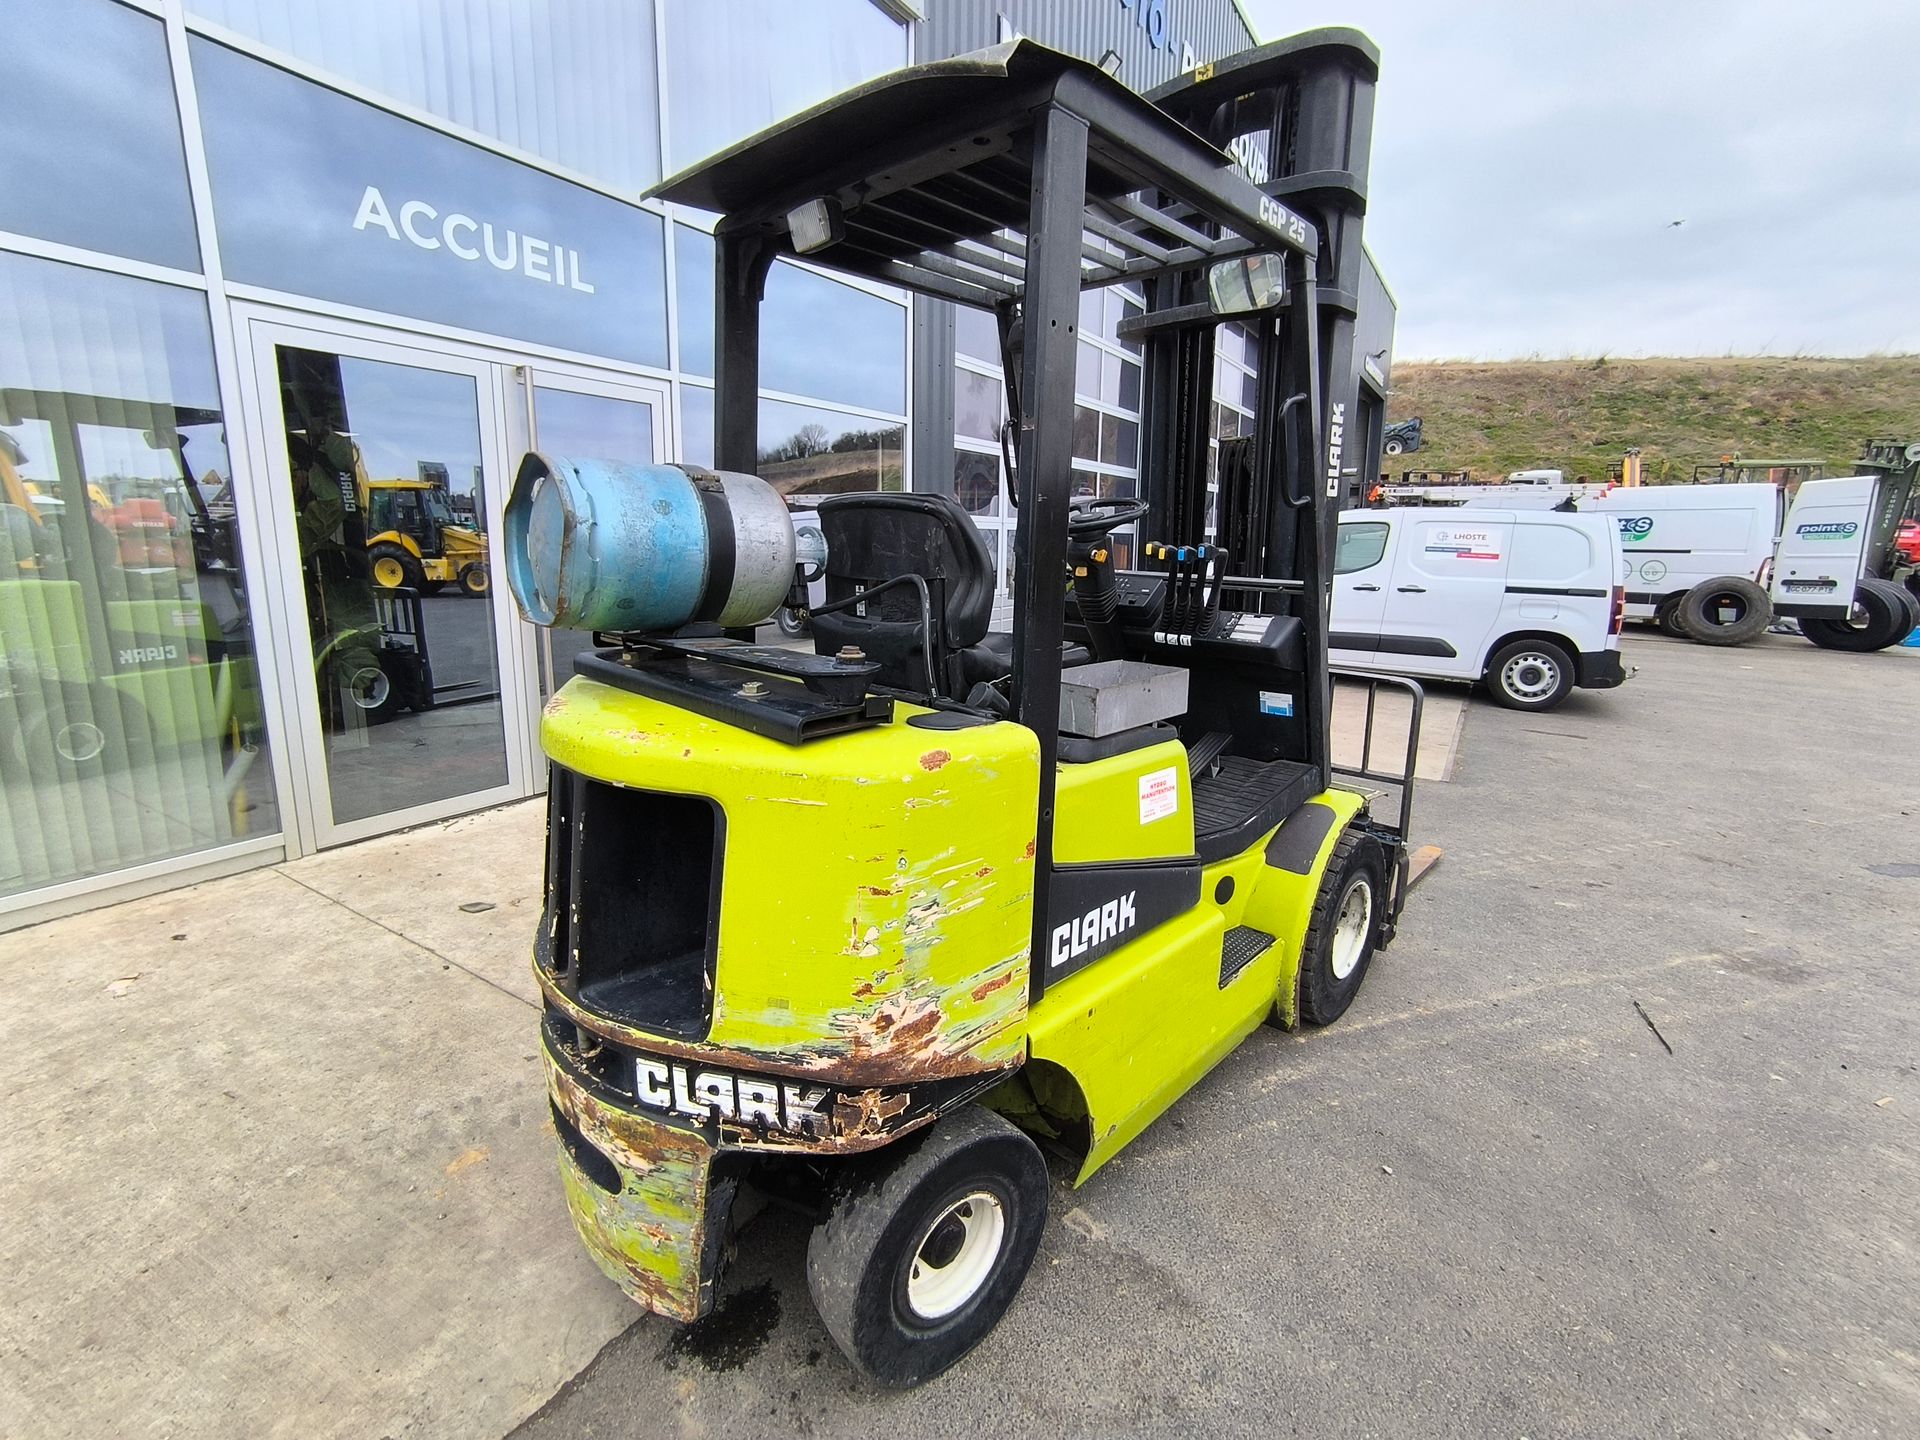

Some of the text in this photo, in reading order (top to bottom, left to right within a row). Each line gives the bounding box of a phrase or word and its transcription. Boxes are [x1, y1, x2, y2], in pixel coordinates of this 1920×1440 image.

[352, 185, 595, 294] ACCUEIL
[1260, 196, 1306, 243] CGP 25
[1326, 402, 1344, 497] CLARK
[1453, 533, 1488, 541] LHOSTE
[1800, 525, 1838, 533] point
[1051, 890, 1136, 968] CLARK
[636, 1057, 834, 1138] CLARK
